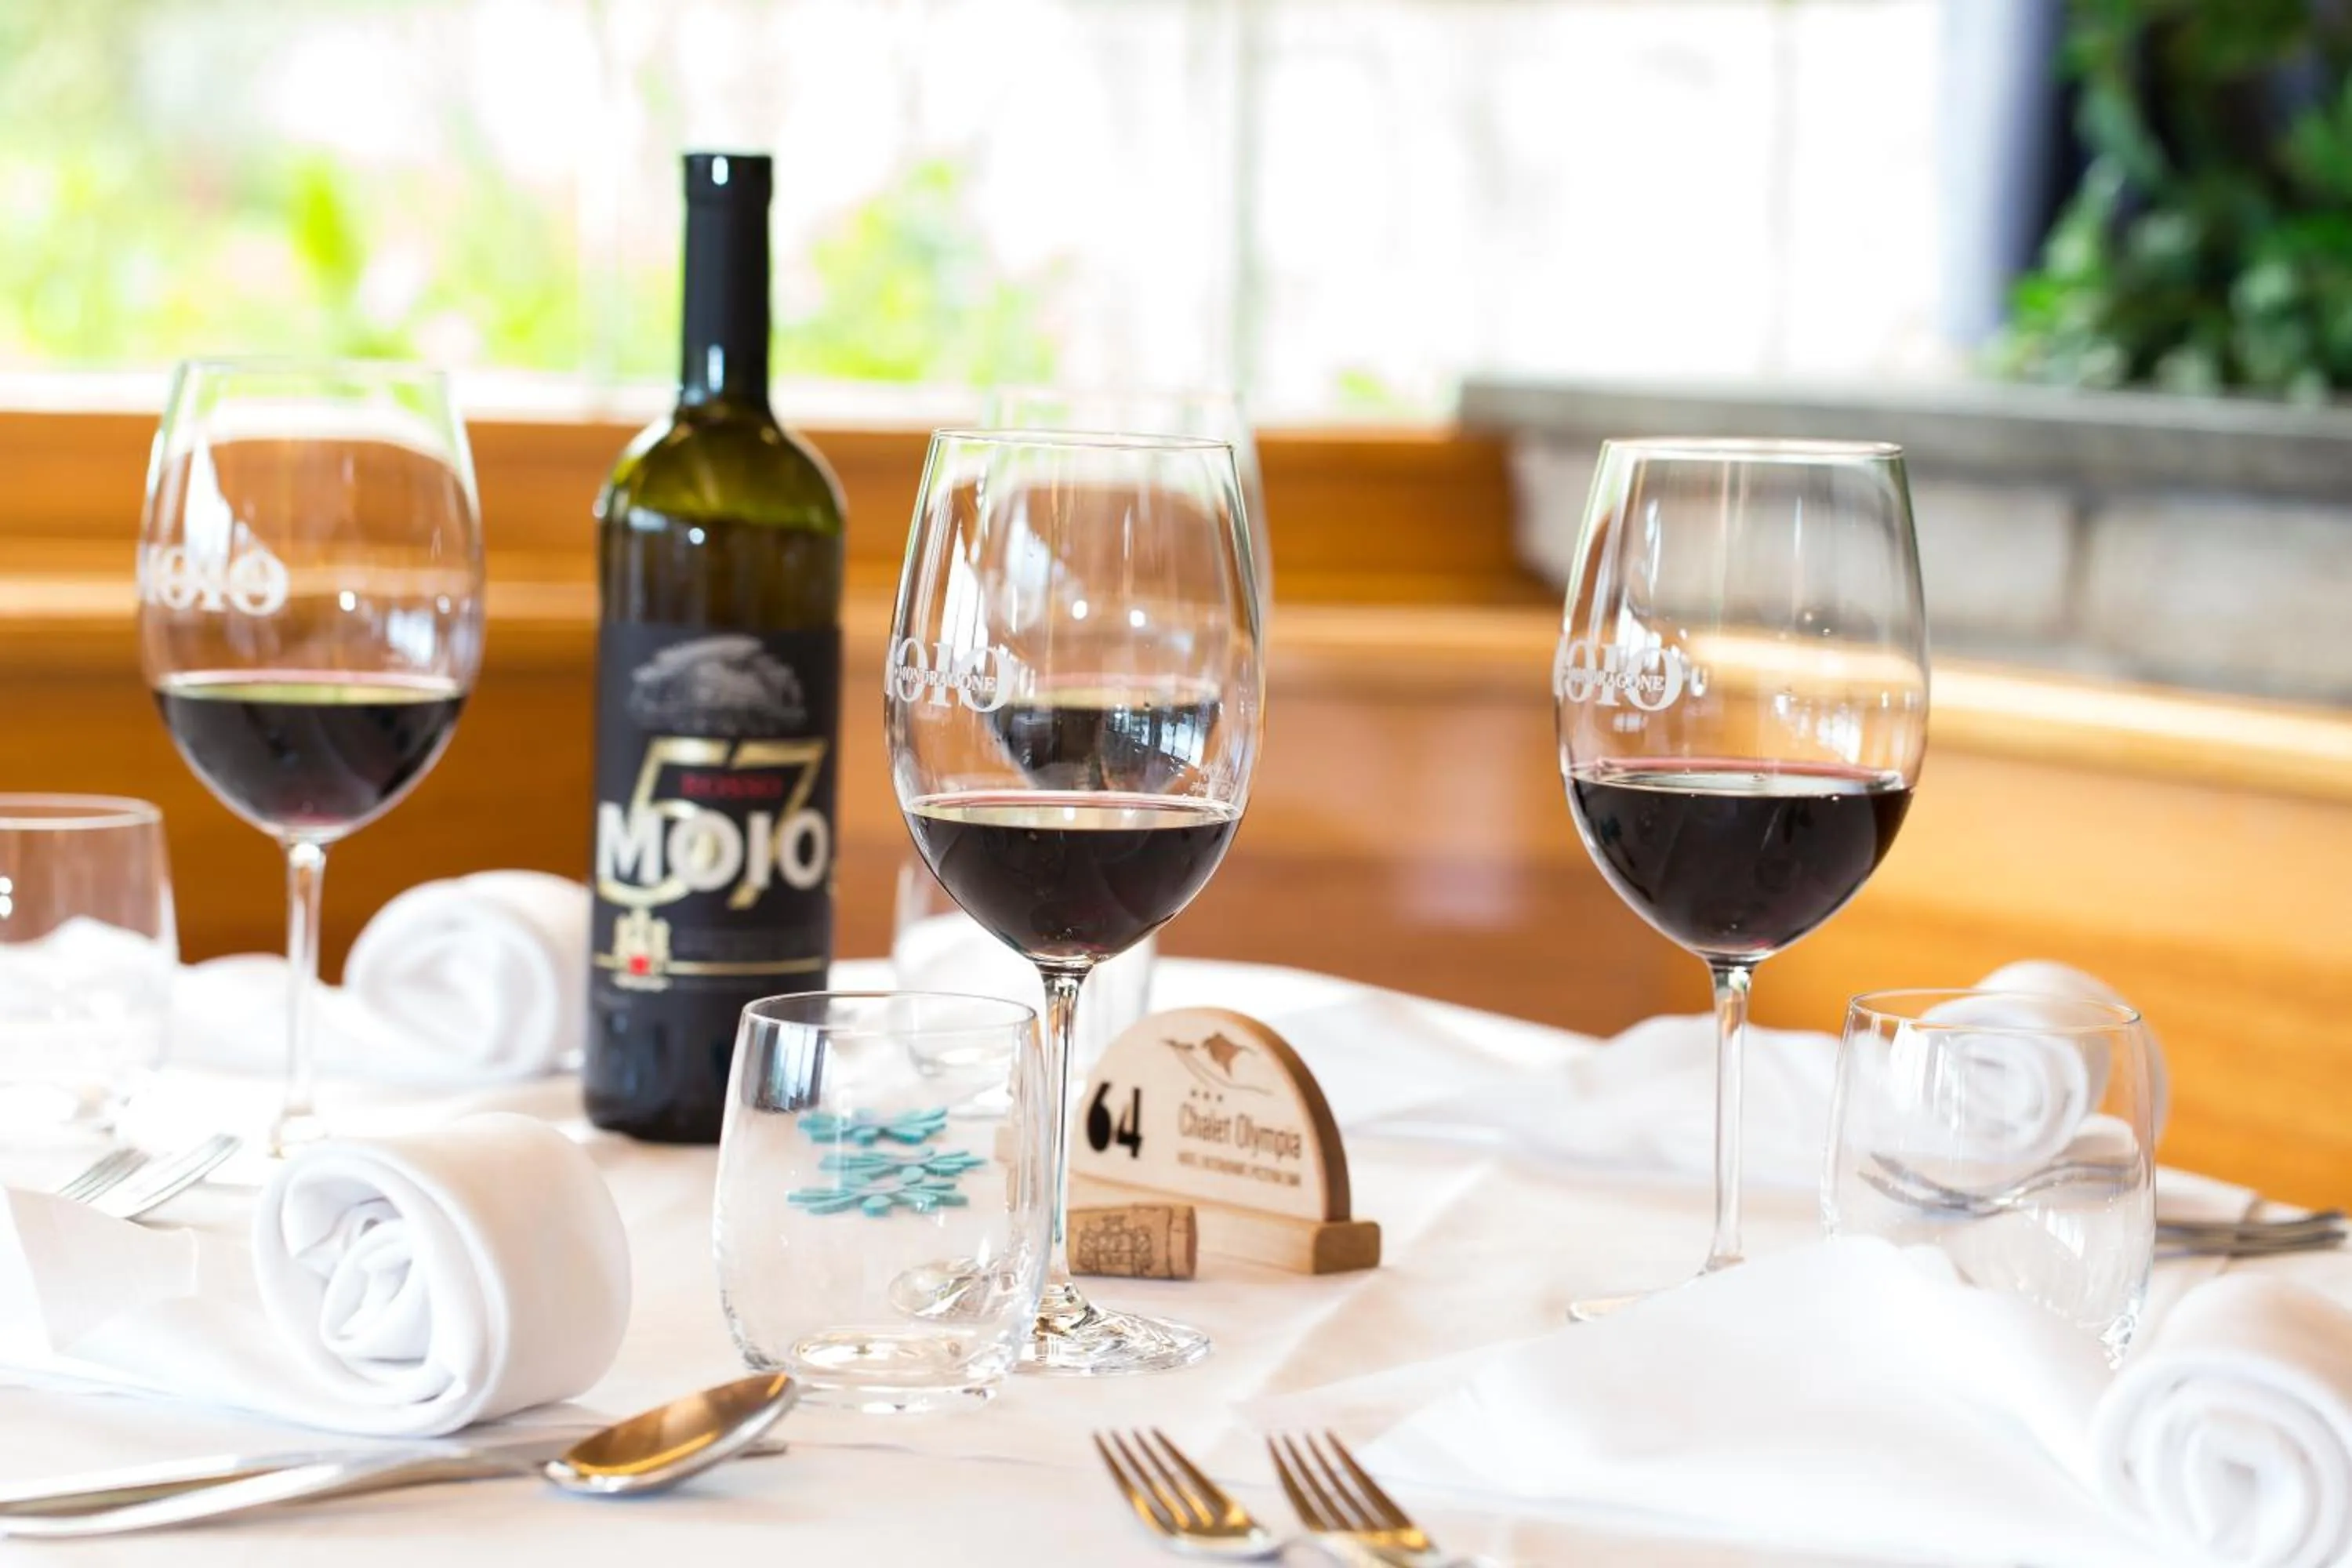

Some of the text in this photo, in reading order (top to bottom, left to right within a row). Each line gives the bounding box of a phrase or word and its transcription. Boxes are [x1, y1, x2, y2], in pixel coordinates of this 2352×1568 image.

[1086, 1081, 1142, 1160] 64
[1178, 1102, 1301, 1162] Chalet Olympia
